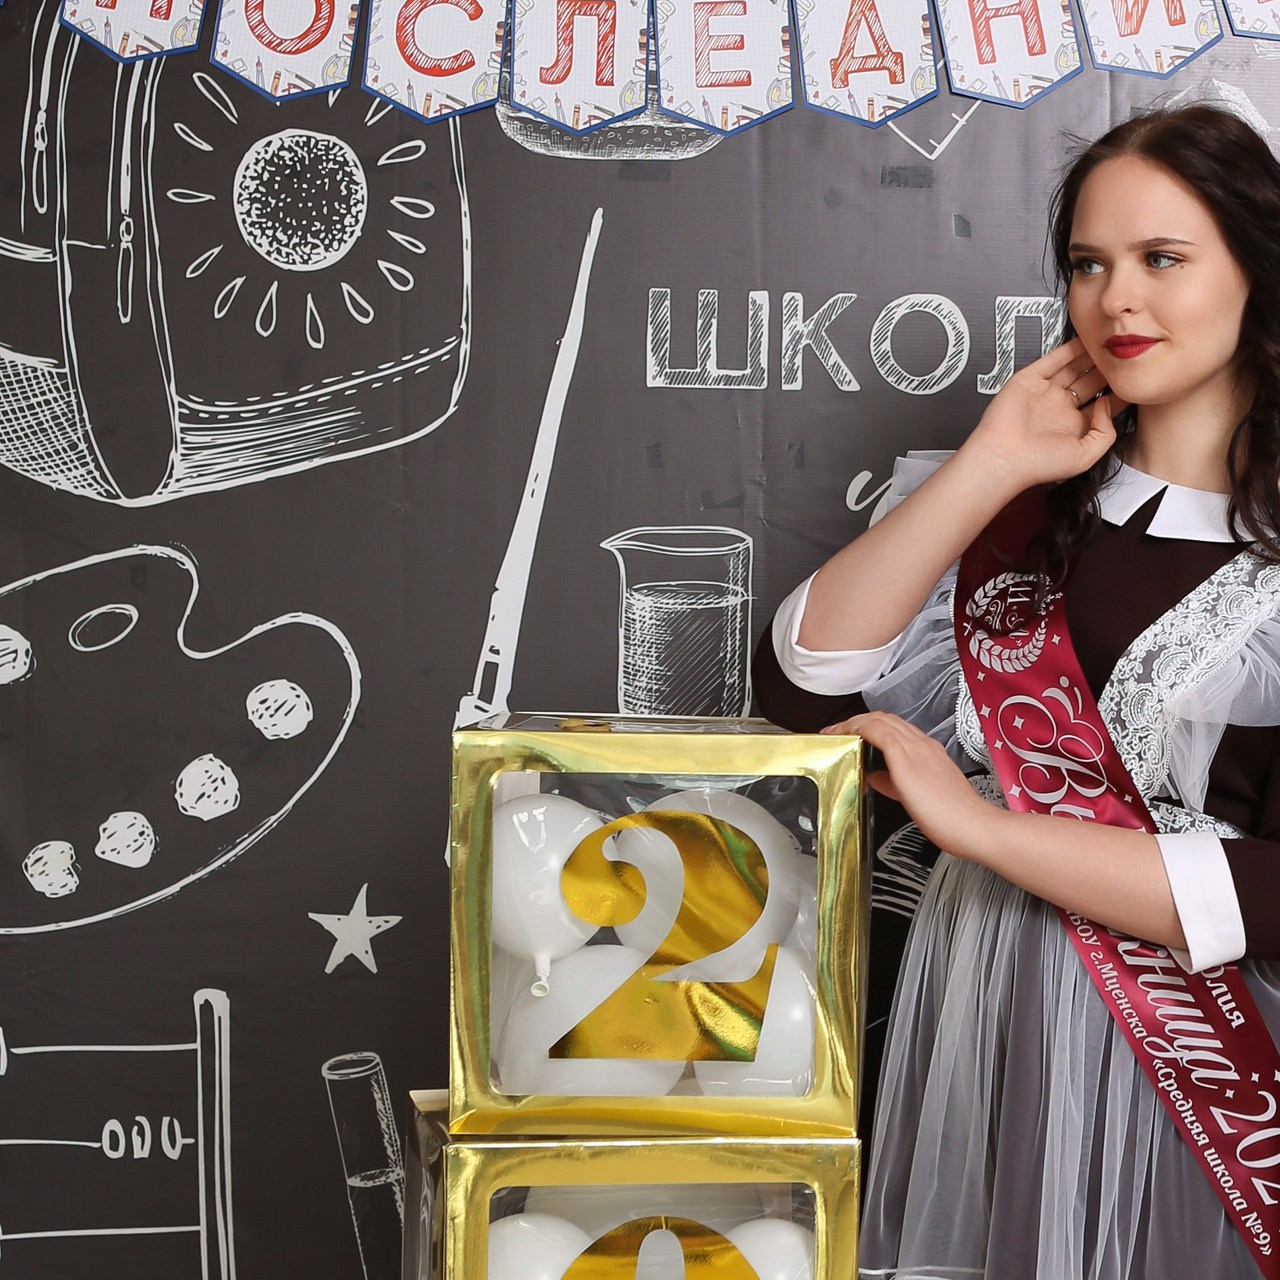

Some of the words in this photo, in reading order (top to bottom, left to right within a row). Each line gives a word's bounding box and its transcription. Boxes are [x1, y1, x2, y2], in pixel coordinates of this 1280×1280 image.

[548, 809, 778, 1062] 2
[998, 676, 1240, 1091] Вкница
[1067, 910, 1102, 948] БОУ
[1091, 951, 1148, 1040] г.Мценска
[1151, 1055, 1210, 1147] «Средняя
[1203, 1147, 1248, 1212] школа
[1240, 1211, 1273, 1258] №9»
